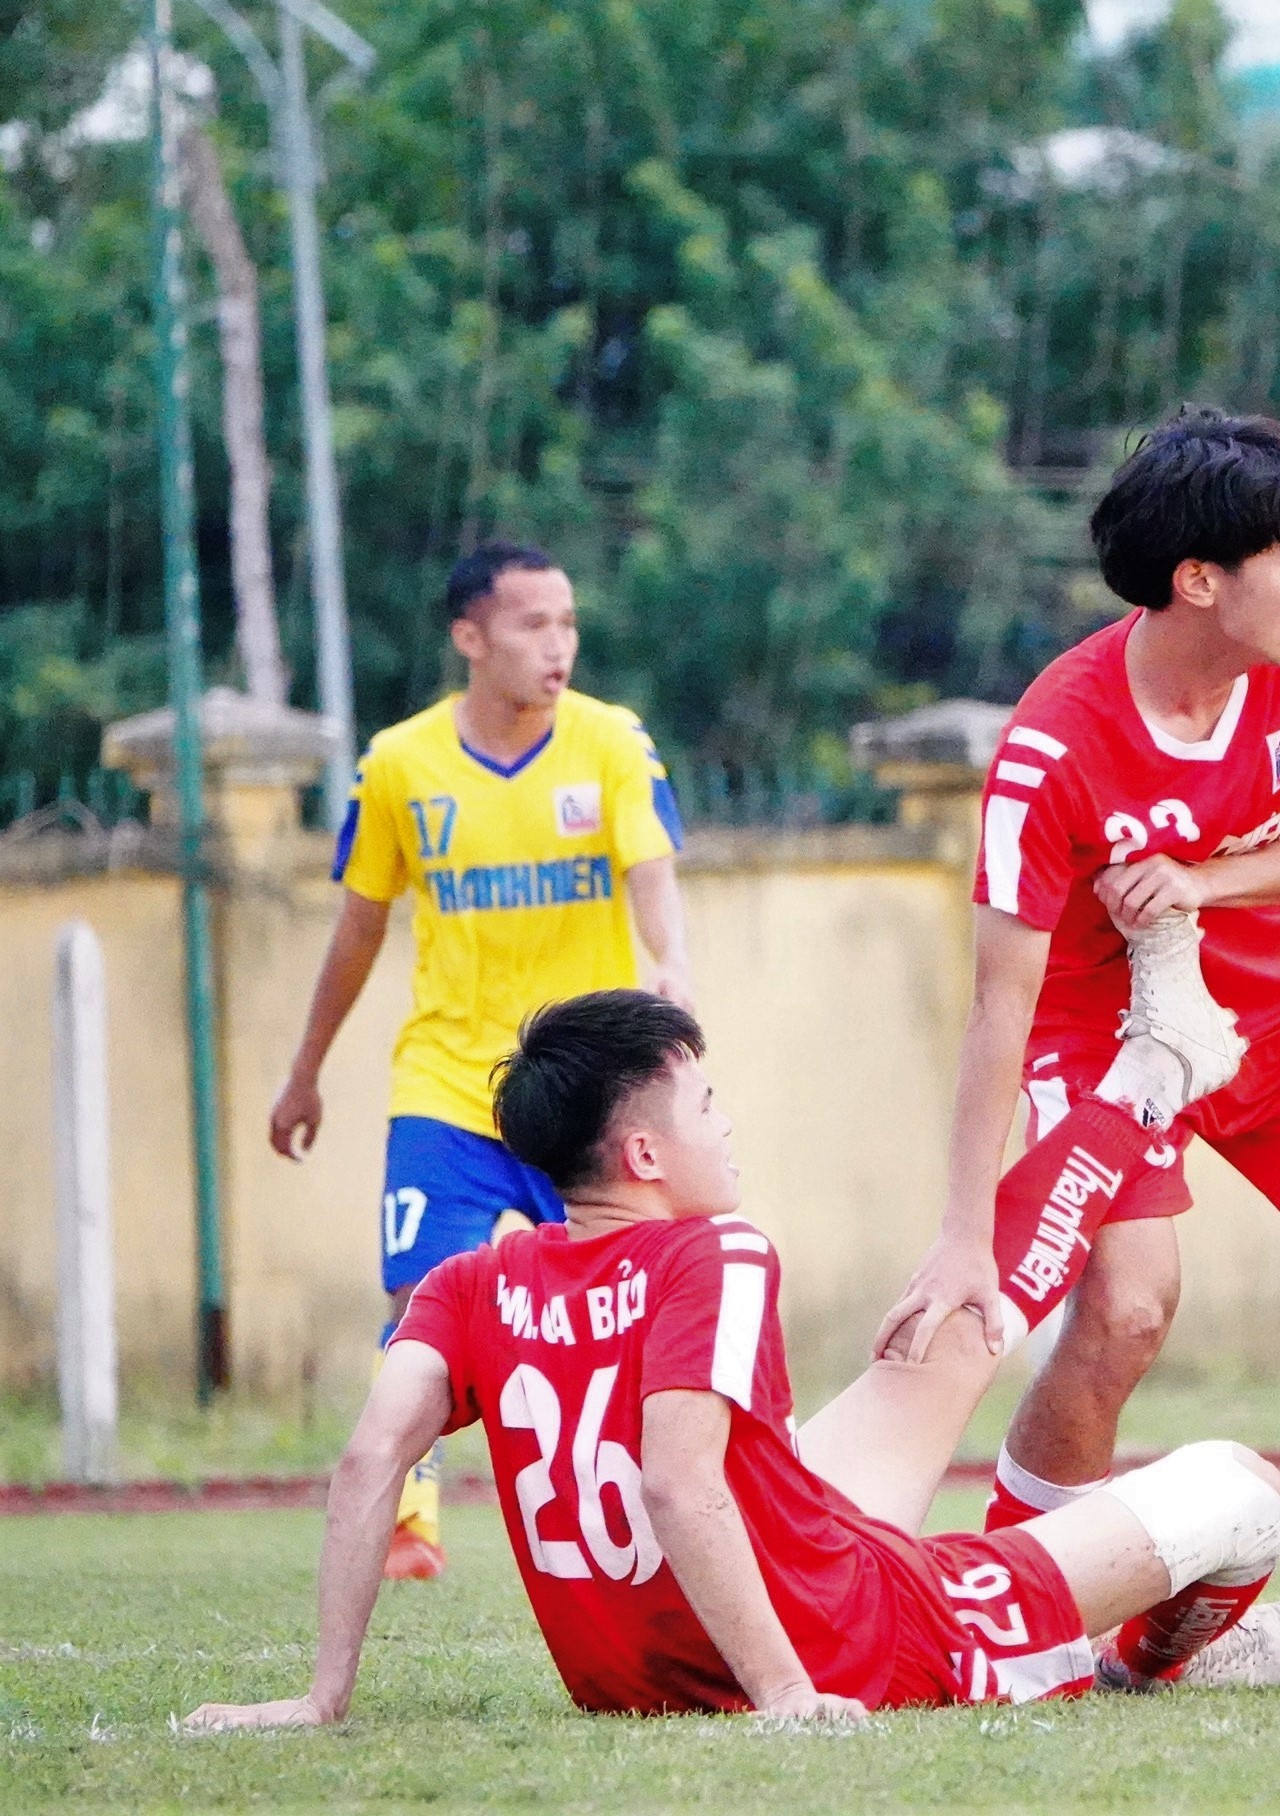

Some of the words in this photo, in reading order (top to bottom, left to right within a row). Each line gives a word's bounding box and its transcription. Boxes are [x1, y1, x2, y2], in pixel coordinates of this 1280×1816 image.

[408, 796, 457, 859] 17
[384, 1186, 428, 1257] 17
[499, 1363, 664, 1586] 26
[941, 1563, 1030, 1647] 26
